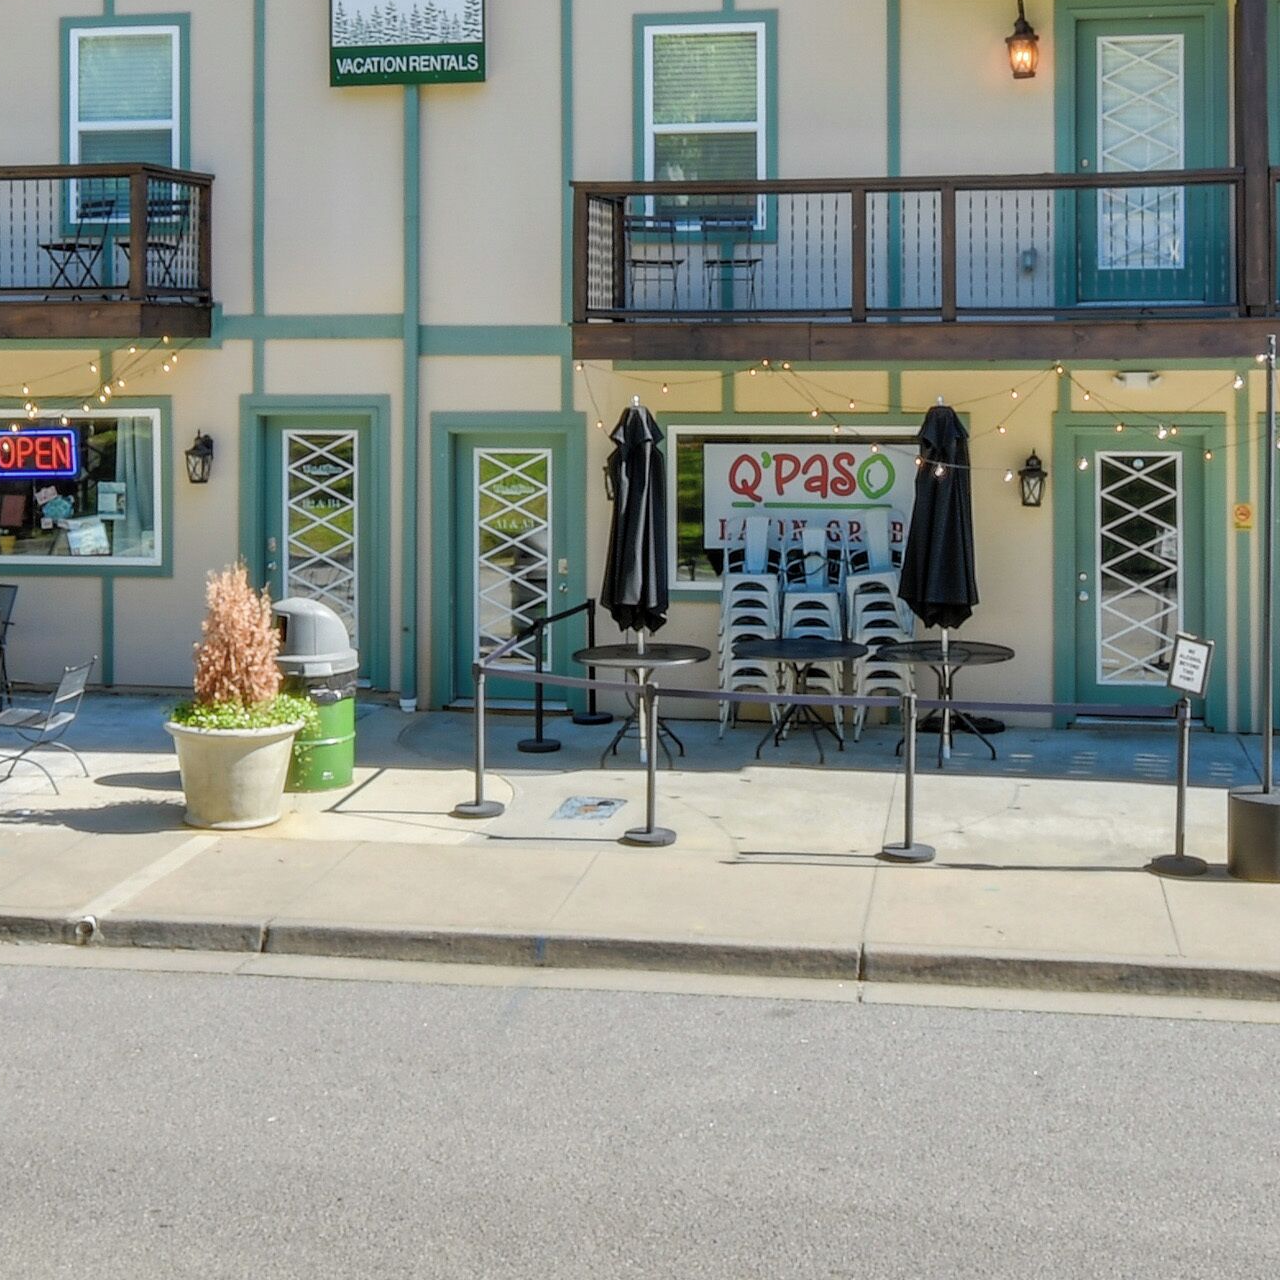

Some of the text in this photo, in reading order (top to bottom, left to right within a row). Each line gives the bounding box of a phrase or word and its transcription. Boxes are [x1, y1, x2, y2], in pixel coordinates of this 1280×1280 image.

[336, 53, 479, 74] VACATION RENTALS
[826, 520, 904, 544] GRB
